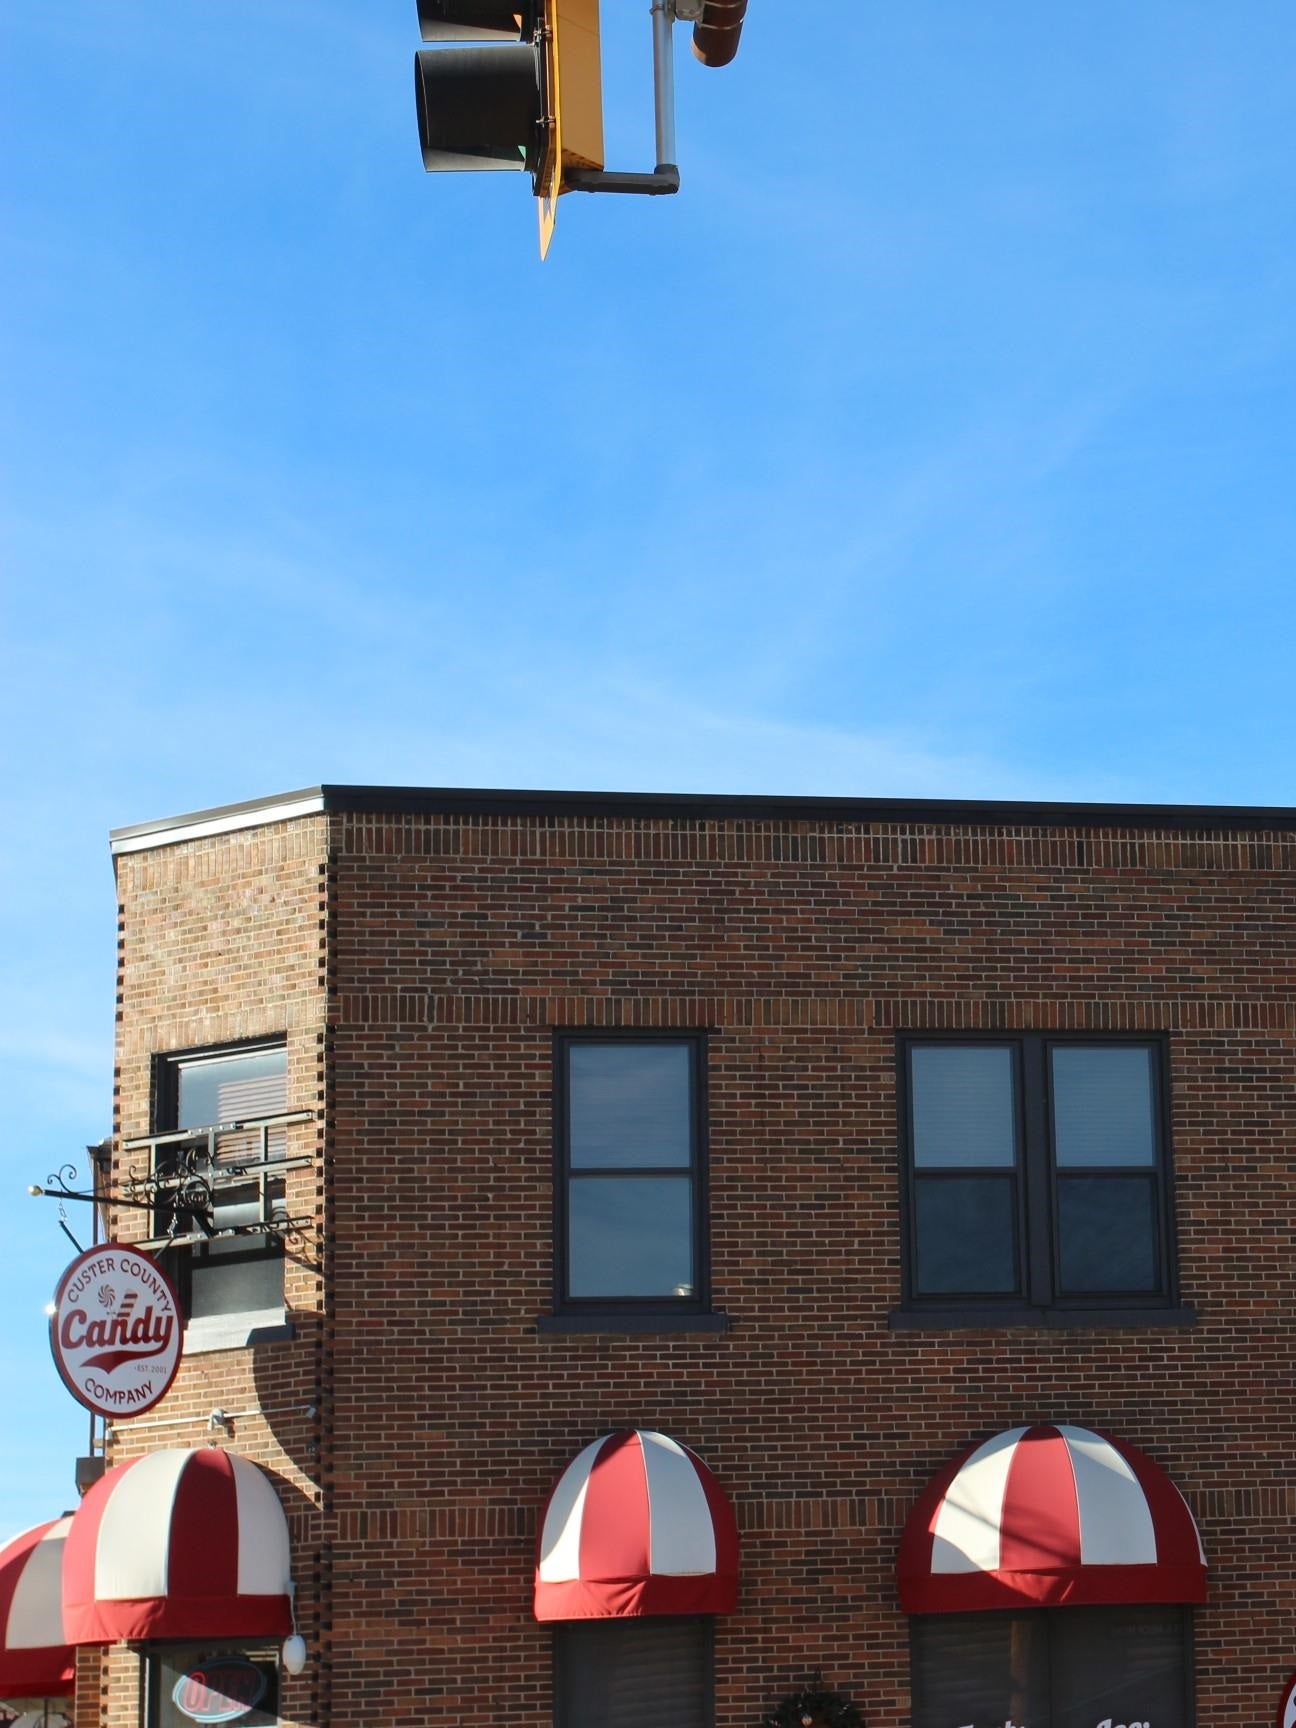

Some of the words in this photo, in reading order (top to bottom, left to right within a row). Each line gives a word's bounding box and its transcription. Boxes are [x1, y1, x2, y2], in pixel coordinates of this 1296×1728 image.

[67, 1257, 116, 1303] CUSTER
[120, 1258, 172, 1312] COUNTY
[61, 1305, 174, 1350] Candy
[84, 1377, 154, 1405] COMPANY
